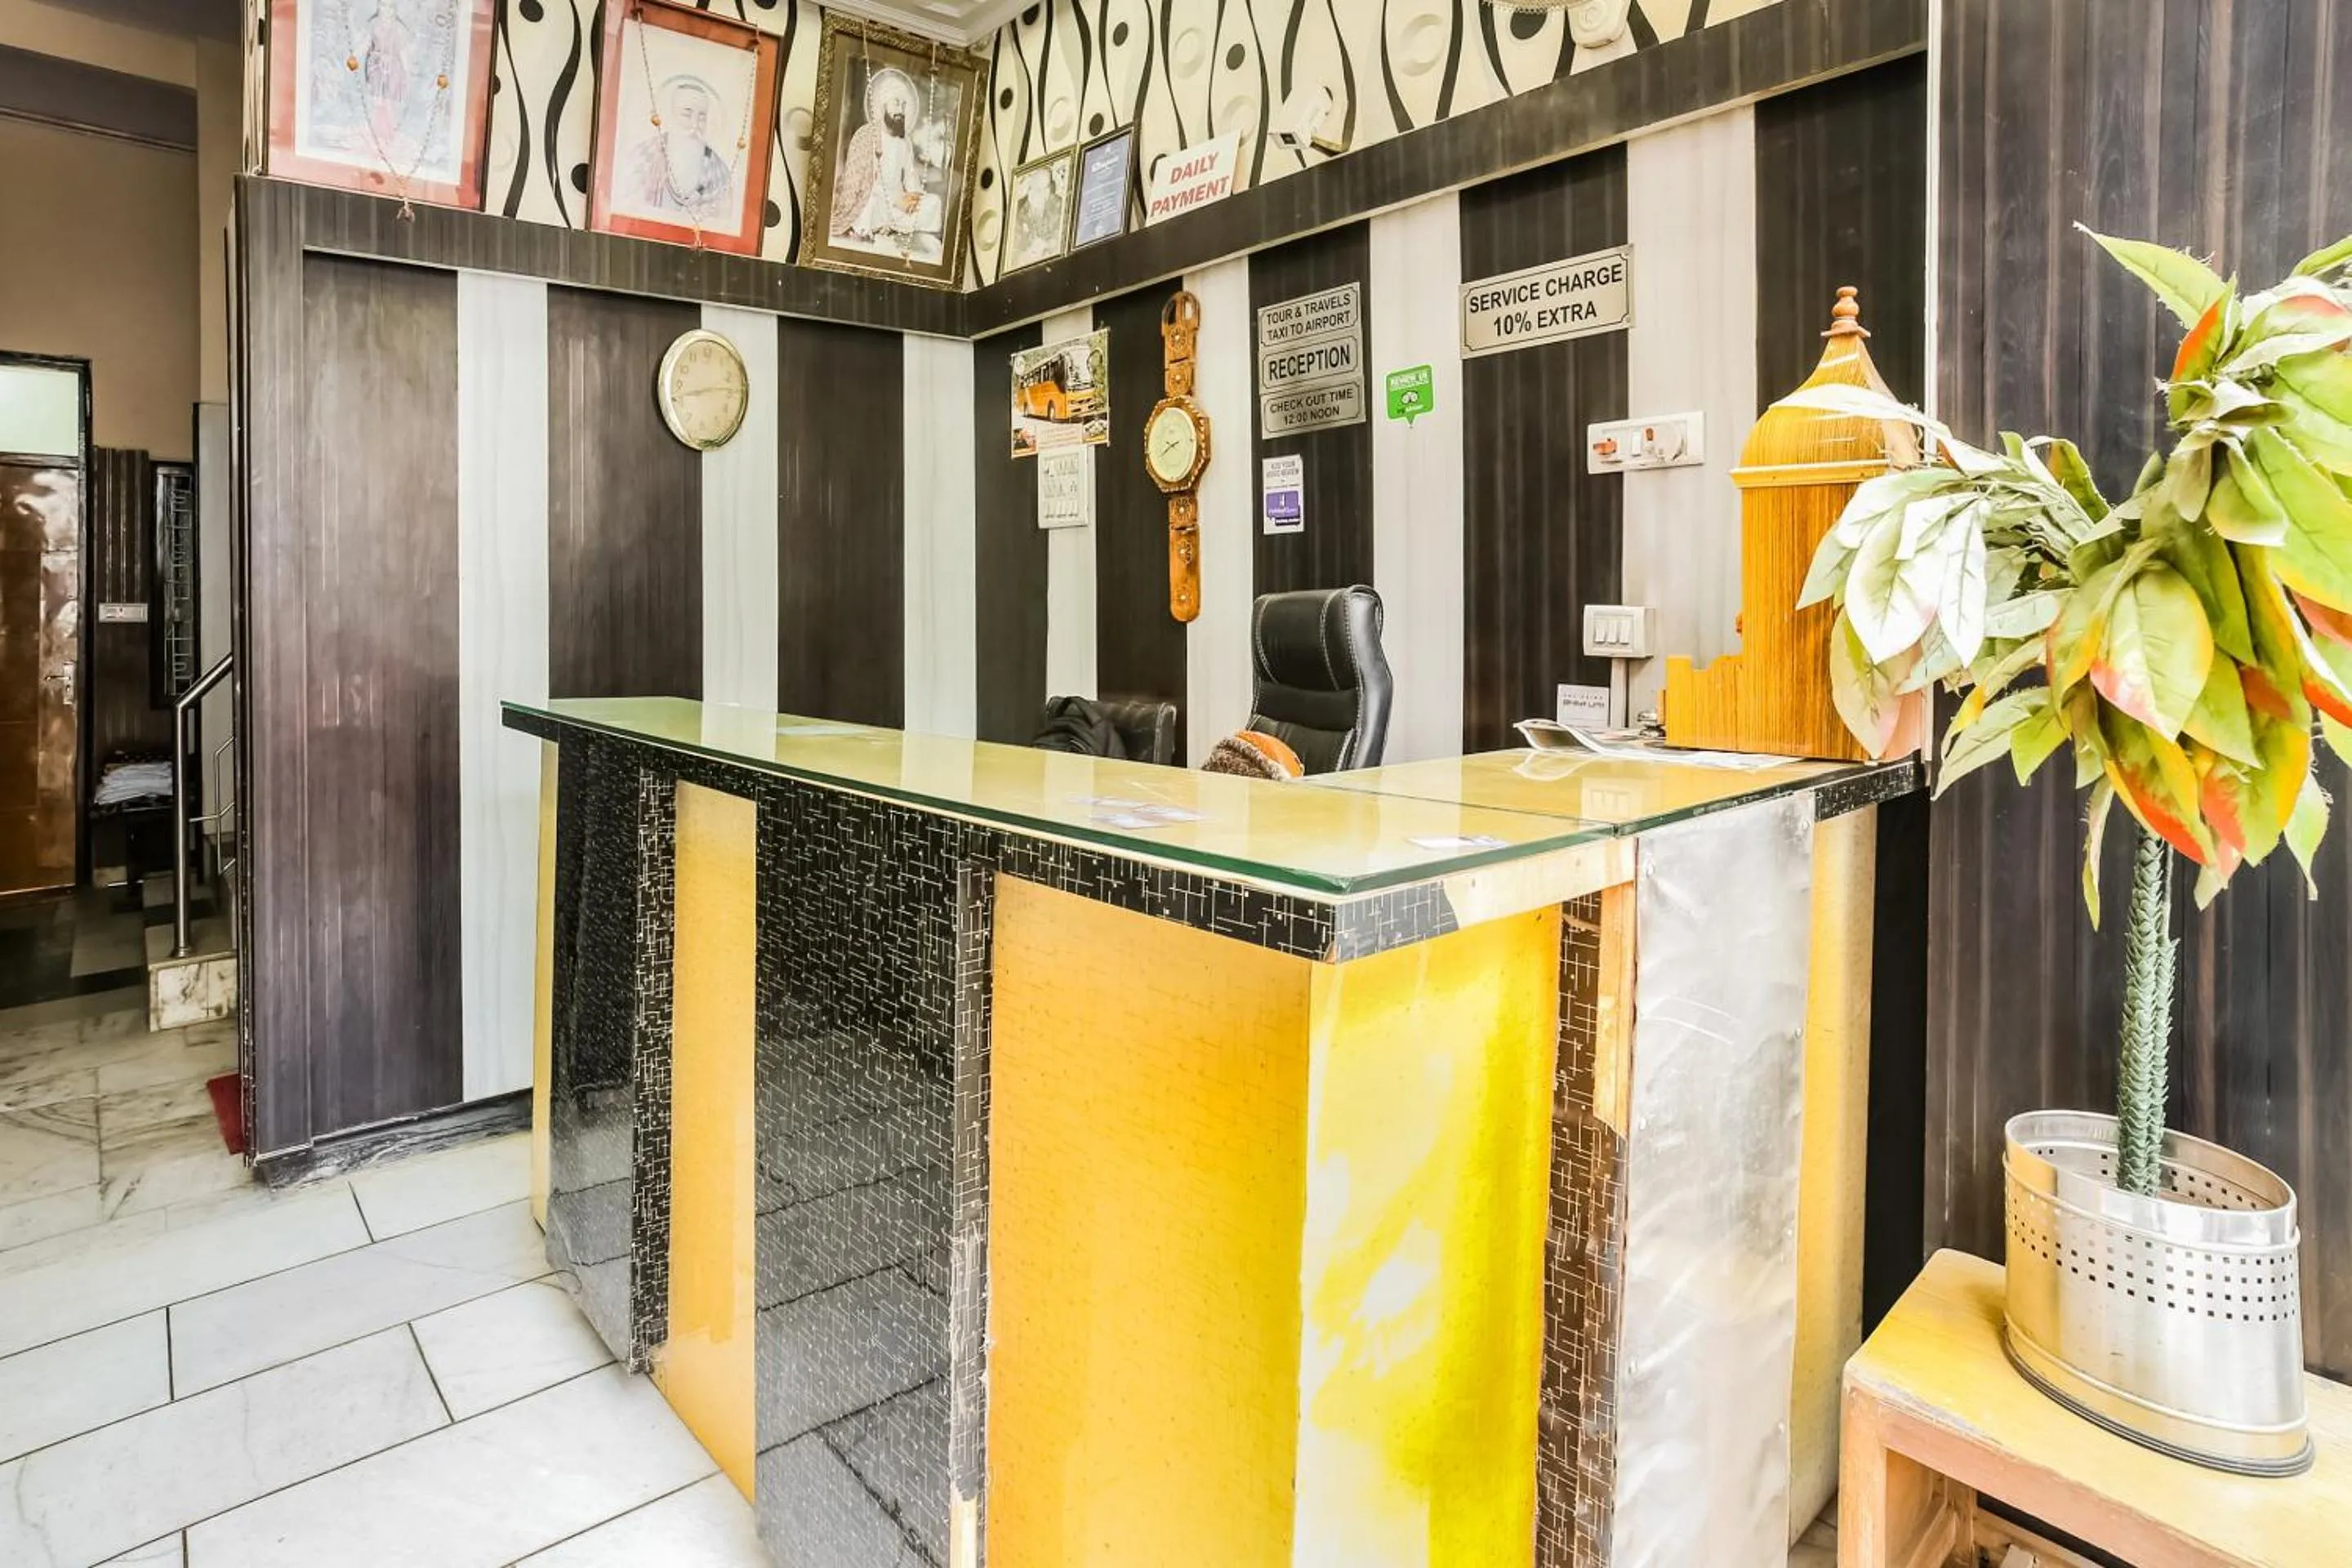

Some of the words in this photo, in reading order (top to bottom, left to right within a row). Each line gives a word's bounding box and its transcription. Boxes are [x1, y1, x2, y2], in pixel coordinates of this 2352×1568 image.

[1169, 151, 1219, 185] DAILY
[1150, 176, 1230, 218] PAYMENT
[1469, 282, 1540, 314] SERVICE
[1545, 263, 1623, 296] CHARGE
[1267, 308, 1293, 325] TOUR
[1294, 306, 1302, 318] &
[1304, 293, 1352, 314] TRAVELS
[1267, 328, 1289, 341] TAXI
[1290, 323, 1304, 336] TO
[1305, 310, 1351, 332] AIRPORT
[1493, 310, 1531, 336] 10%
[1537, 301, 1597, 329] EXTRA
[1269, 344, 1351, 381] RECEPTION
[1269, 399, 1304, 414] CHECK
[1306, 394, 1327, 407] OUT
[1330, 388, 1354, 403] TIME
[1310, 406, 1340, 421] NOON
